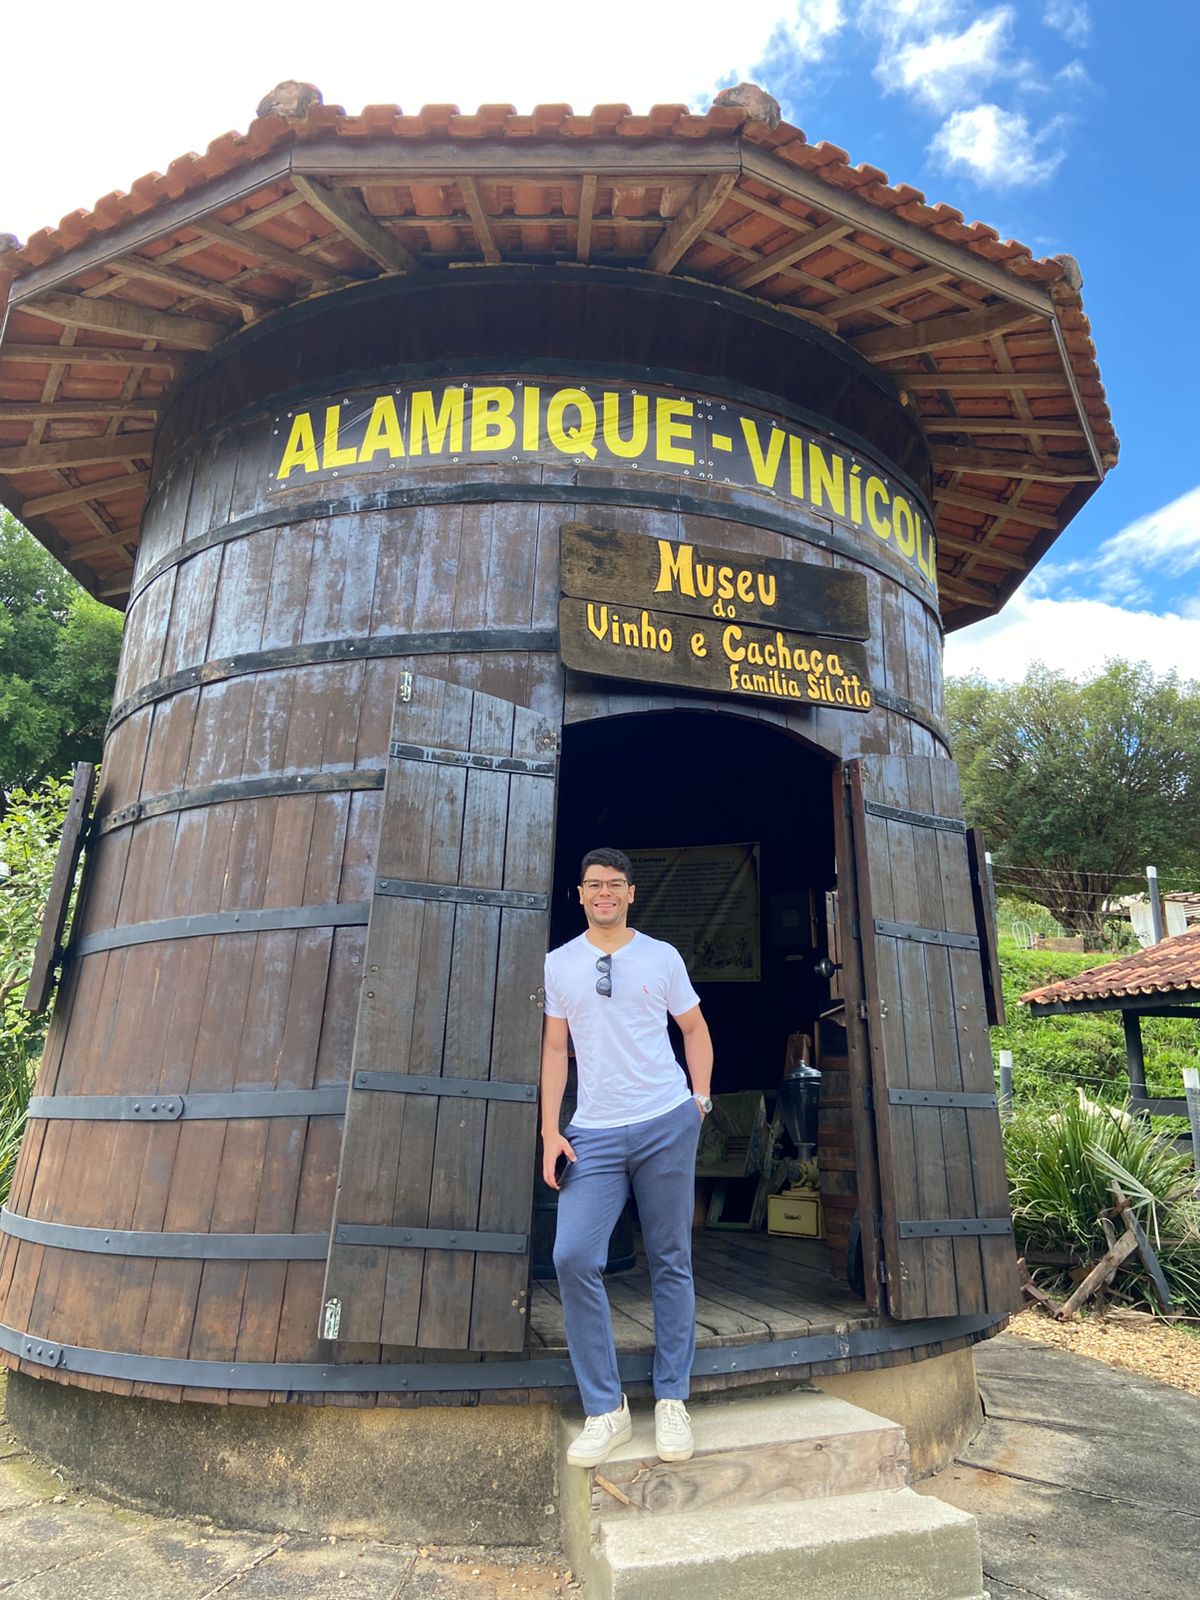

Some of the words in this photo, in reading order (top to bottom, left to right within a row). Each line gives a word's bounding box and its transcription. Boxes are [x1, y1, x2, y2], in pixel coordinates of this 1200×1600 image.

[276, 385, 695, 480] ALAMBIQUE
[654, 540, 776, 606] Museu
[586, 603, 673, 653] Vinho
[690, 632, 707, 657] e
[722, 625, 844, 678] Cachaça
[713, 599, 736, 619] do
[807, 673, 871, 707] Silotto
